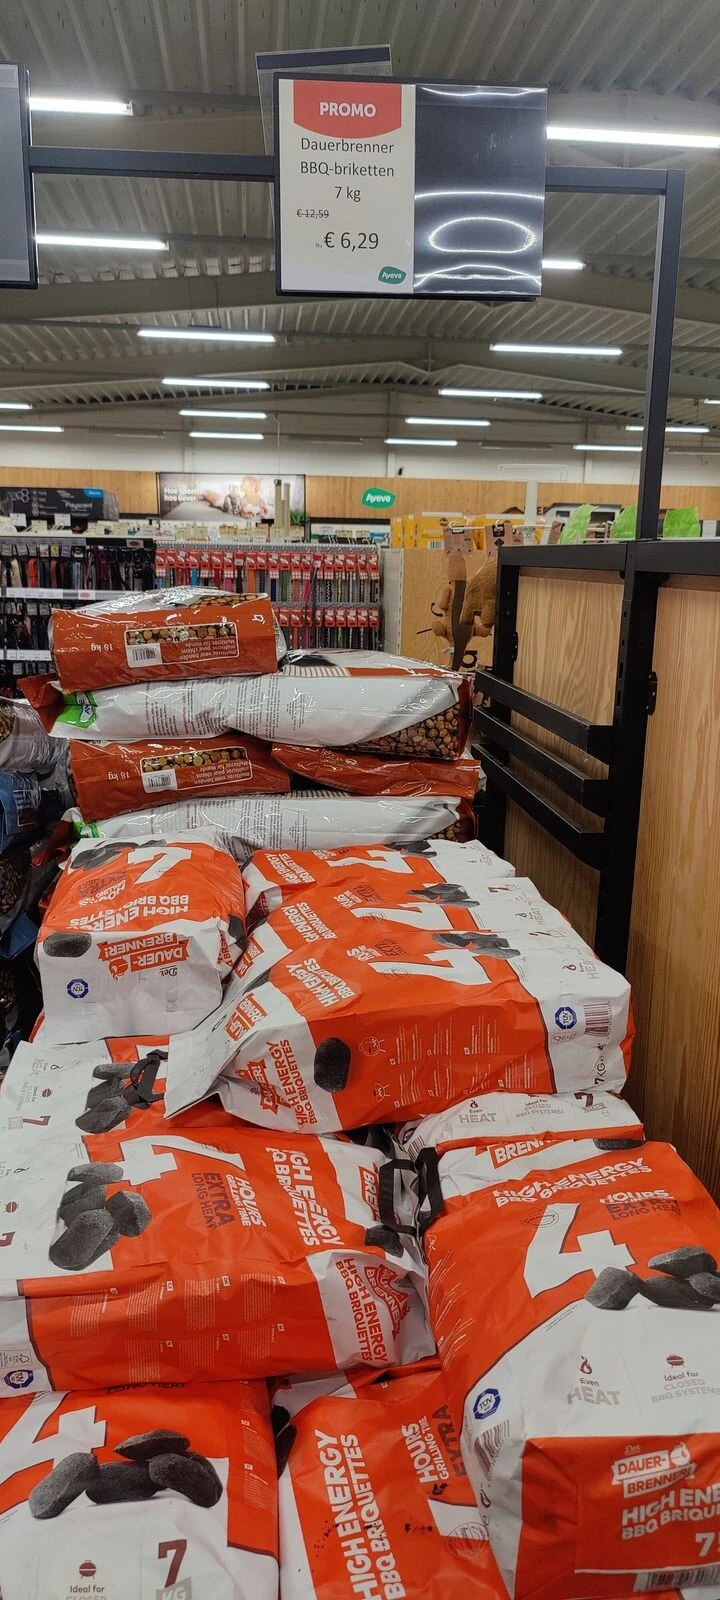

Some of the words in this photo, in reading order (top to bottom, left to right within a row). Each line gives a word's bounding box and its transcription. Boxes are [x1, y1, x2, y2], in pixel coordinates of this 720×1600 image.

[319, 101, 377, 117] PROMO
[300, 137, 394, 154] Dauerbrenner
[300, 161, 394, 177] BBQ-briketten
[334, 187, 342, 199] 7
[346, 187, 361, 202] kg
[304, 209, 329, 219] 12,59
[323, 231, 335, 248] €
[340, 232, 379, 252] 6,29
[382, 270, 402, 280] Aveve
[366, 493, 391, 503] Aveve
[91, 642, 102, 653] kg
[103, 643, 114, 651] 18
[108, 772, 119, 781] kg
[144, 906, 188, 916] HIGH
[159, 895, 189, 905] BBQ
[104, 932, 178, 957] BRENNER!
[133, 946, 183, 966] DAUER-
[160, 967, 178, 976] Der
[266, 1041, 296, 1096] ENERGY
[282, 1040, 310, 1104] BRIQUETTES
[288, 1094, 308, 1126] HIGH
[302, 1100, 318, 1124] BBQ
[459, 1112, 496, 1124] HEAT
[553, 1158, 644, 1187] ENERGY
[192, 1172, 206, 1201] LONG
[203, 1172, 235, 1229] EXTRA
[235, 1176, 266, 1229] HOURS
[612, 1208, 650, 1220] LONG
[524, 1202, 637, 1299] 4
[336, 1261, 354, 1290] BBQ
[350, 1290, 372, 1362] BRIQUETTES
[343, 1258, 372, 1299] HIGH
[364, 1301, 388, 1362] ENERGY
[580, 1378, 600, 1387] Even
[664, 1372, 686, 1382] Ideal
[568, 1387, 620, 1406] HEAT
[418, 1416, 432, 1434] TIME
[0, 1391, 107, 1487] 4
[432, 1404, 466, 1476] EXTRA
[402, 1423, 439, 1484] HOURS
[424, 1433, 450, 1480] GRILLING
[618, 1455, 666, 1475] DAUER-
[314, 1429, 362, 1538] ENERGY
[628, 1466, 692, 1494] BRENNER!
[340, 1434, 391, 1552] BRIQUETTES
[622, 1490, 675, 1526] HIGH
[621, 1518, 658, 1540] BBQ
[158, 1539, 188, 1588] 7
[341, 1536, 382, 1600] HIGH
[376, 1553, 406, 1600] BBQ
[70, 1585, 91, 1593] Ideal
[92, 1585, 104, 1593] for
